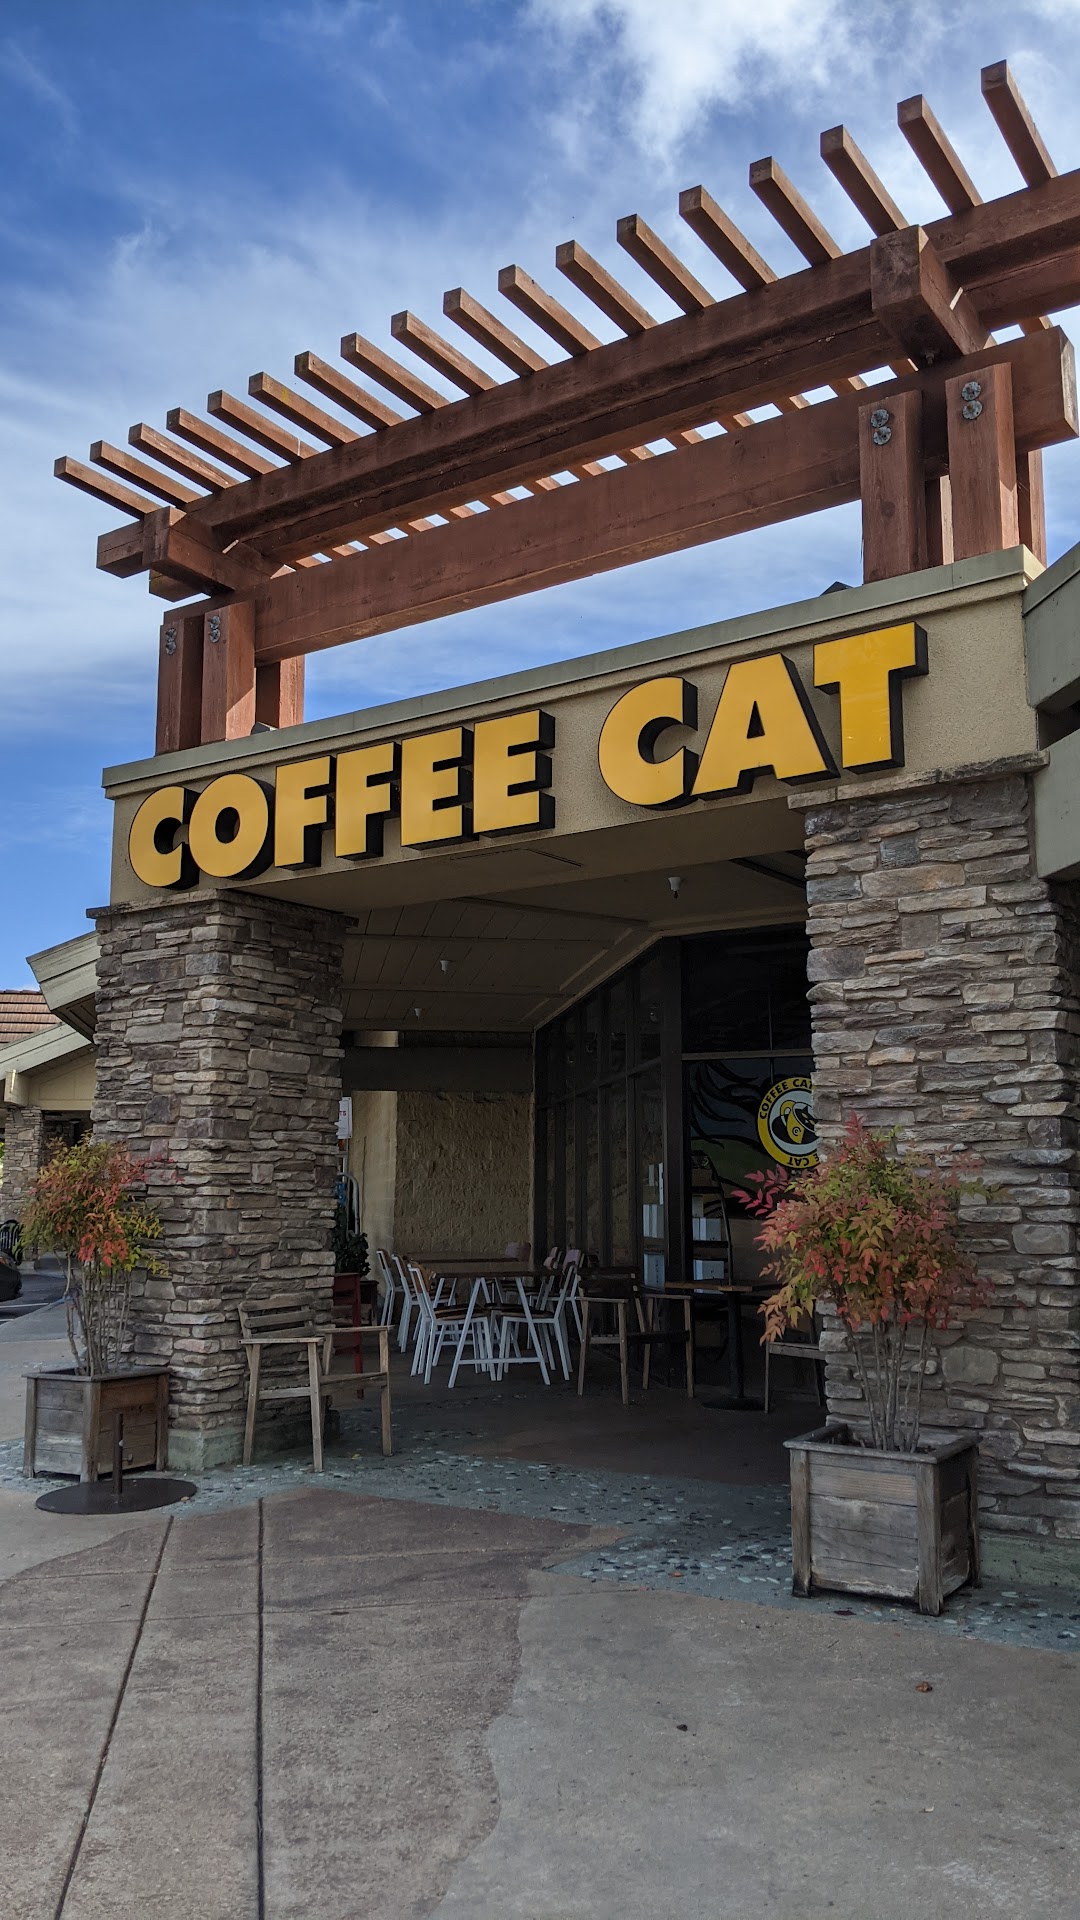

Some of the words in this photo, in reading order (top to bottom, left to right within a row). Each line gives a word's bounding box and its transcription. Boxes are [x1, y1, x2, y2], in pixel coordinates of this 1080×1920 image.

[129, 709, 555, 890] COFFEE
[598, 622, 929, 811] CAT
[759, 1081, 789, 1120] COFFEE
[787, 1156, 810, 1167] CAT
